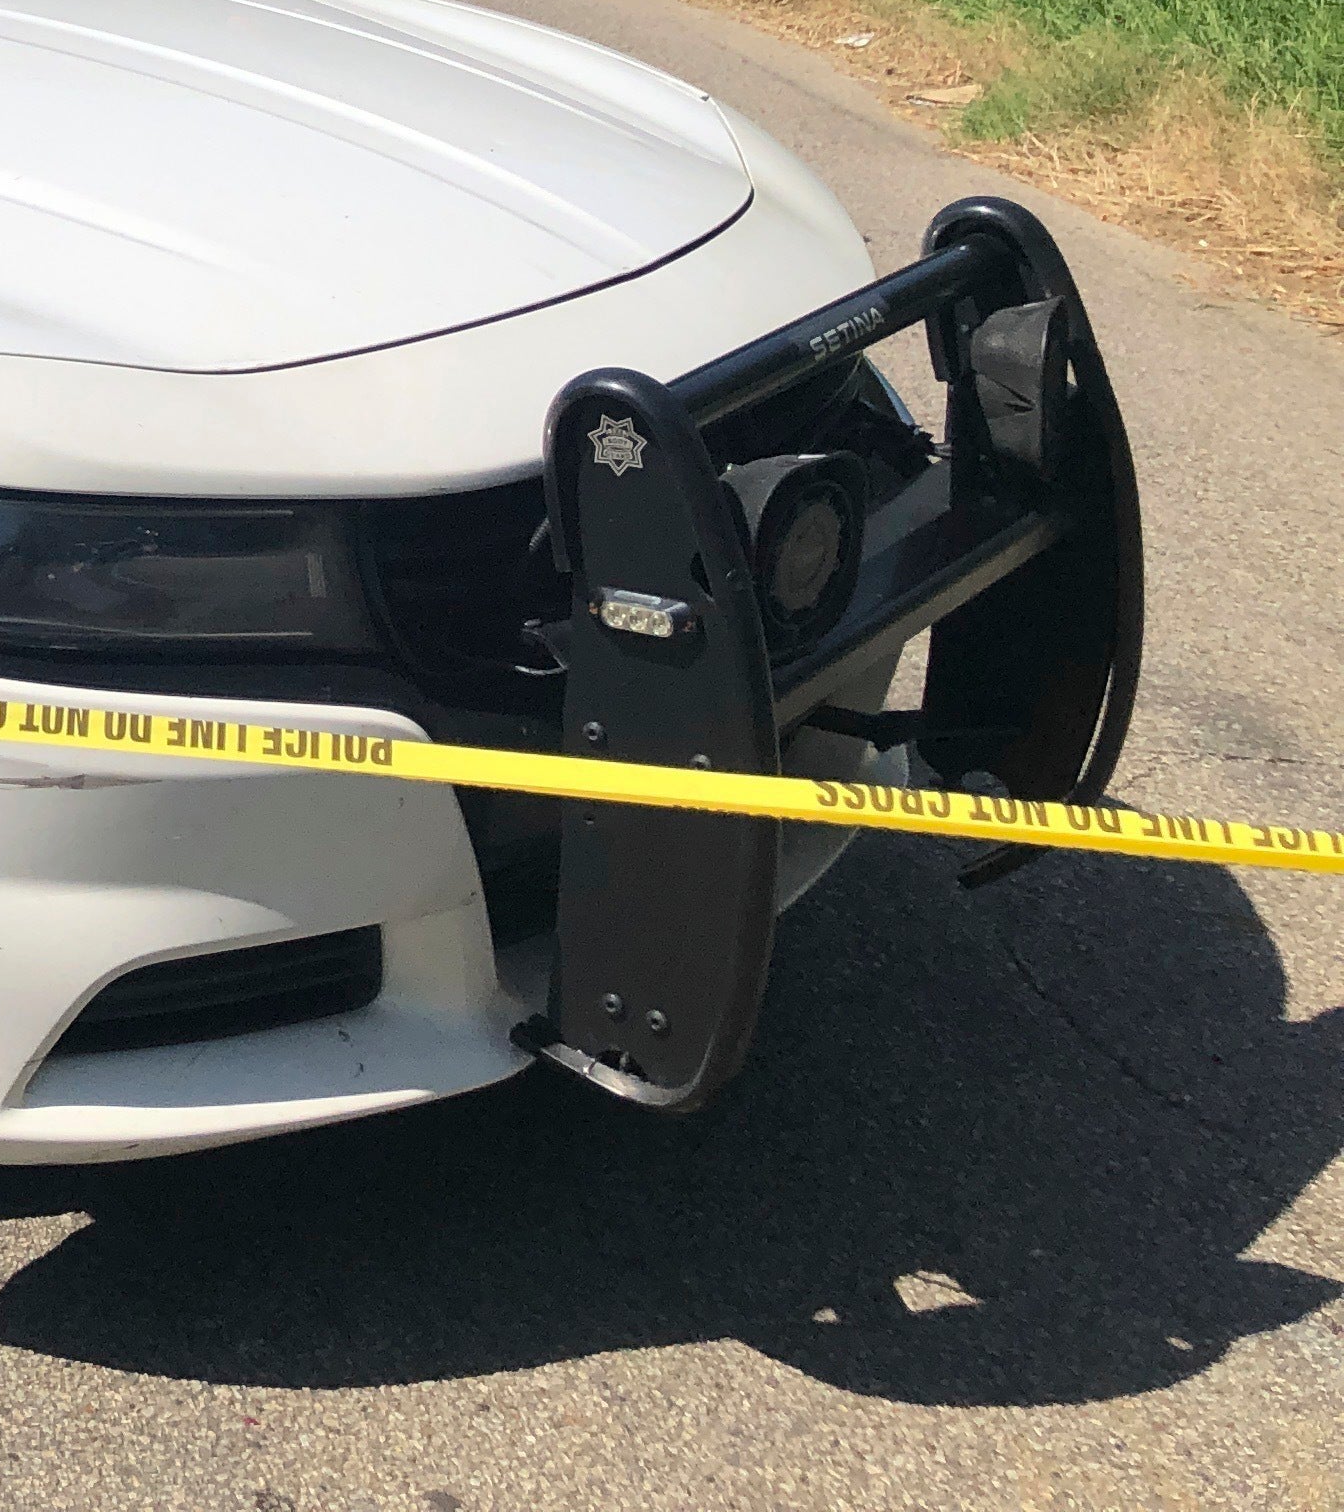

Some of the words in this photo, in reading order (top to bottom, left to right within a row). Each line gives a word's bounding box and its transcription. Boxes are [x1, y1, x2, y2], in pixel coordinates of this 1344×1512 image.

[809, 307, 884, 361] SETINA
[18, 704, 90, 737] NOT
[104, 710, 152, 743] DO
[166, 718, 247, 752] LINE
[263, 727, 392, 766] POLICE
[817, 781, 952, 819] CROSS
[970, 795, 1050, 828] NOT
[1142, 812, 1237, 845] LINE
